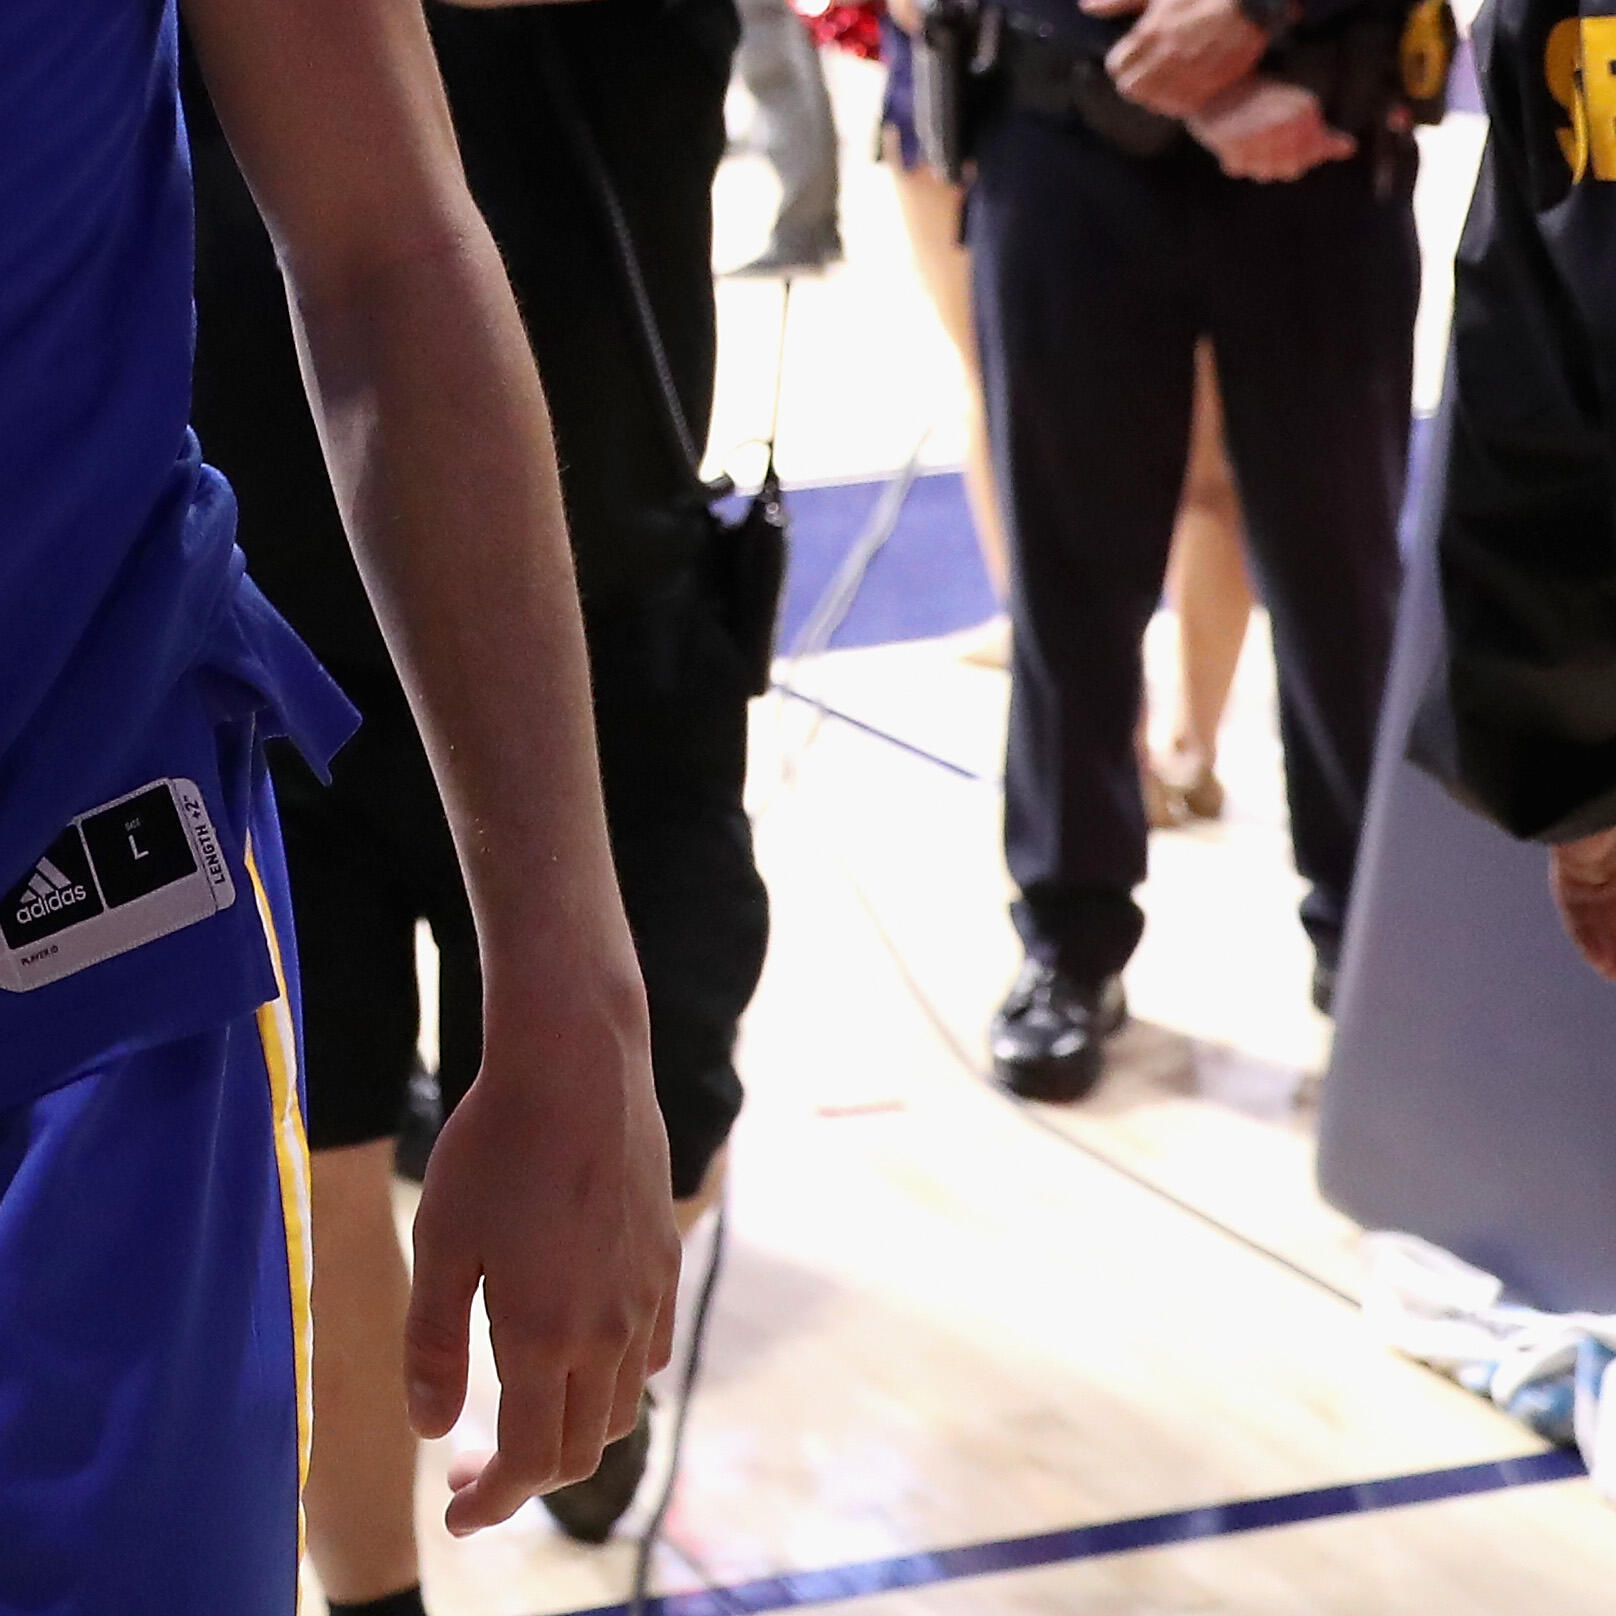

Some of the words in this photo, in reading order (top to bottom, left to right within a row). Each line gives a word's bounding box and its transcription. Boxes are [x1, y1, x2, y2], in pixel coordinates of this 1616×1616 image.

[128, 835, 149, 860] L
[195, 825, 226, 885] LENGTH
[16, 885, 87, 924] adidas
